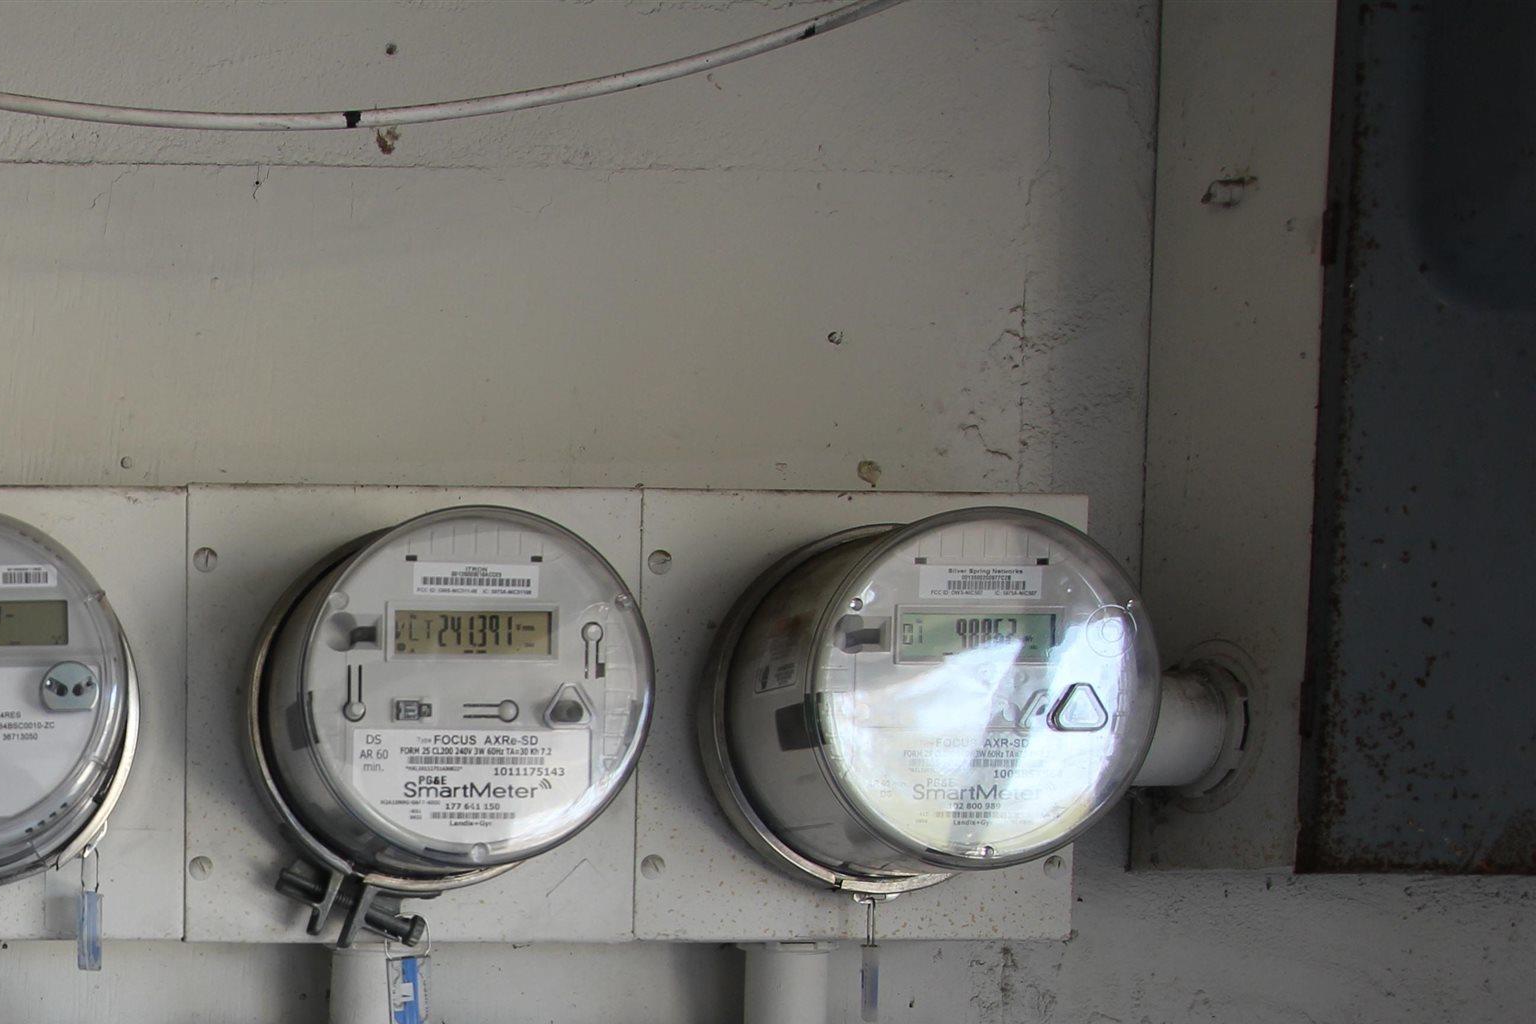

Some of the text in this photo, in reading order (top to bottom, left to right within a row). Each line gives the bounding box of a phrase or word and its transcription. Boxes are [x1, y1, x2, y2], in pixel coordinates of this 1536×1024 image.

[366, 735, 381, 745] DS
[434, 735, 538, 745] FOCUS AXRe-SD
[360, 749, 388, 760] AR 60
[363, 763, 384, 771] min.
[494, 768, 565, 776] 1011175143
[419, 776, 447, 785] PG&E
[404, 781, 538, 798] SmartMeter
